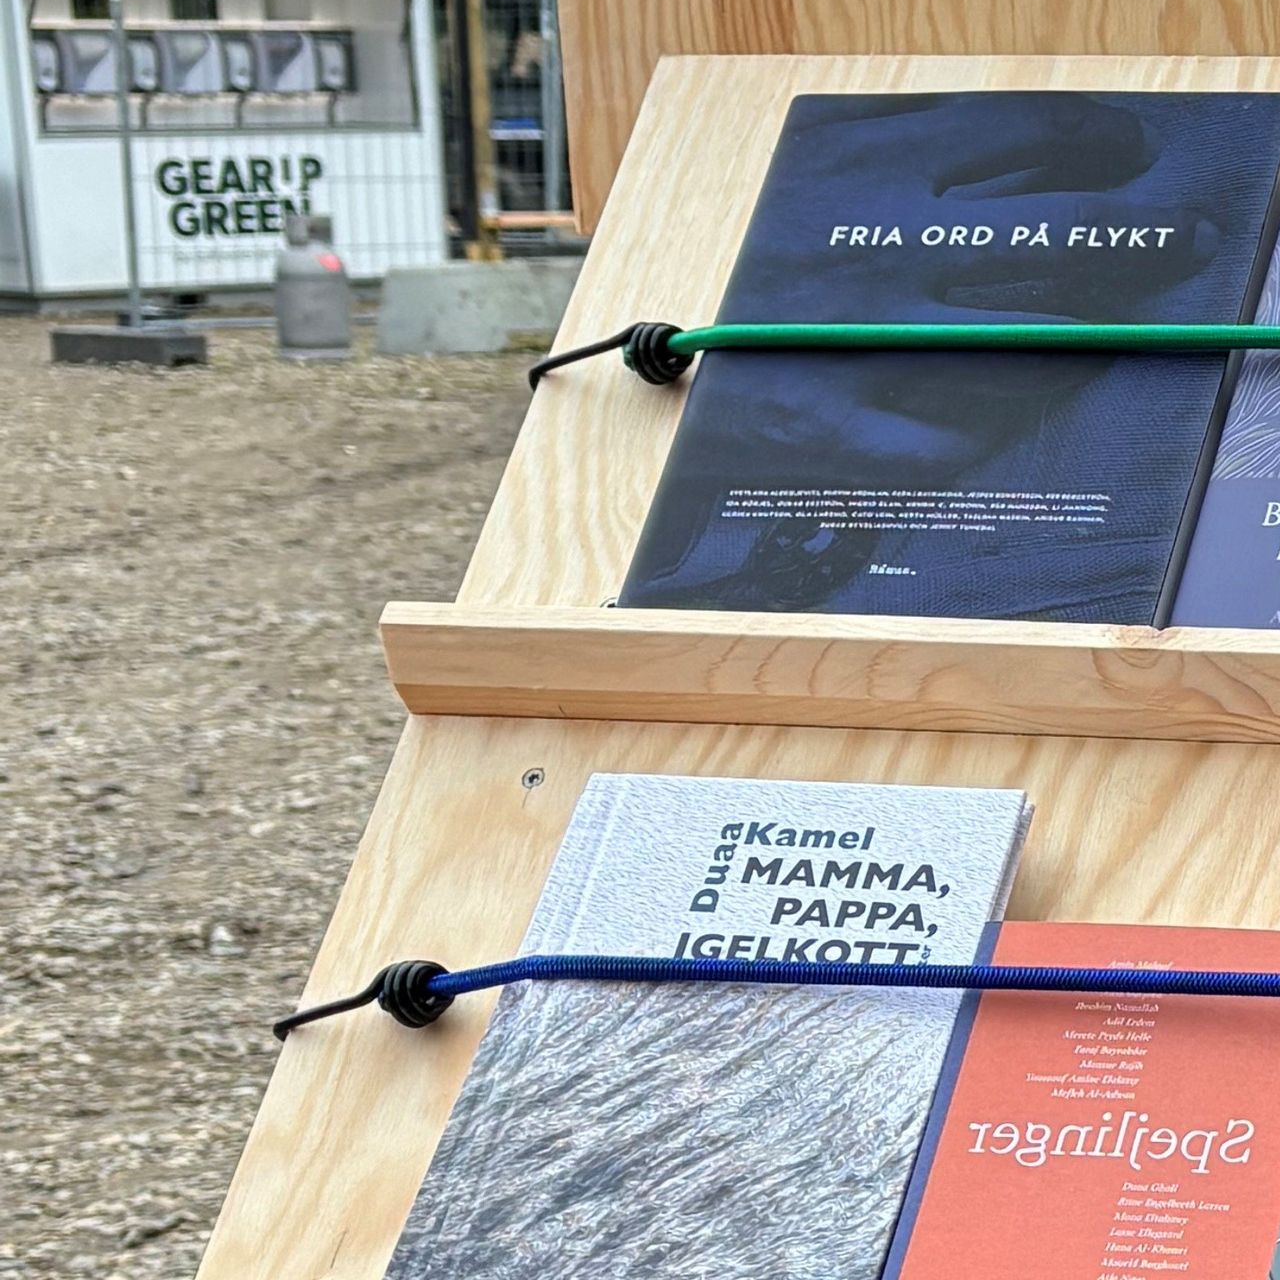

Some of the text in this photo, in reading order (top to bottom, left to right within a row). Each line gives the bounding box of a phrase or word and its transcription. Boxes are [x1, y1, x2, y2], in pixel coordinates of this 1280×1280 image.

[830, 222, 1174, 249] FRIA ORD PÅ FLYKT
[743, 820, 875, 851] Kamel
[689, 822, 744, 913] Duaa
[740, 856, 951, 900] MAMMA,
[769, 896, 939, 939] PAPPA,
[673, 931, 921, 964] IGELKOTT
